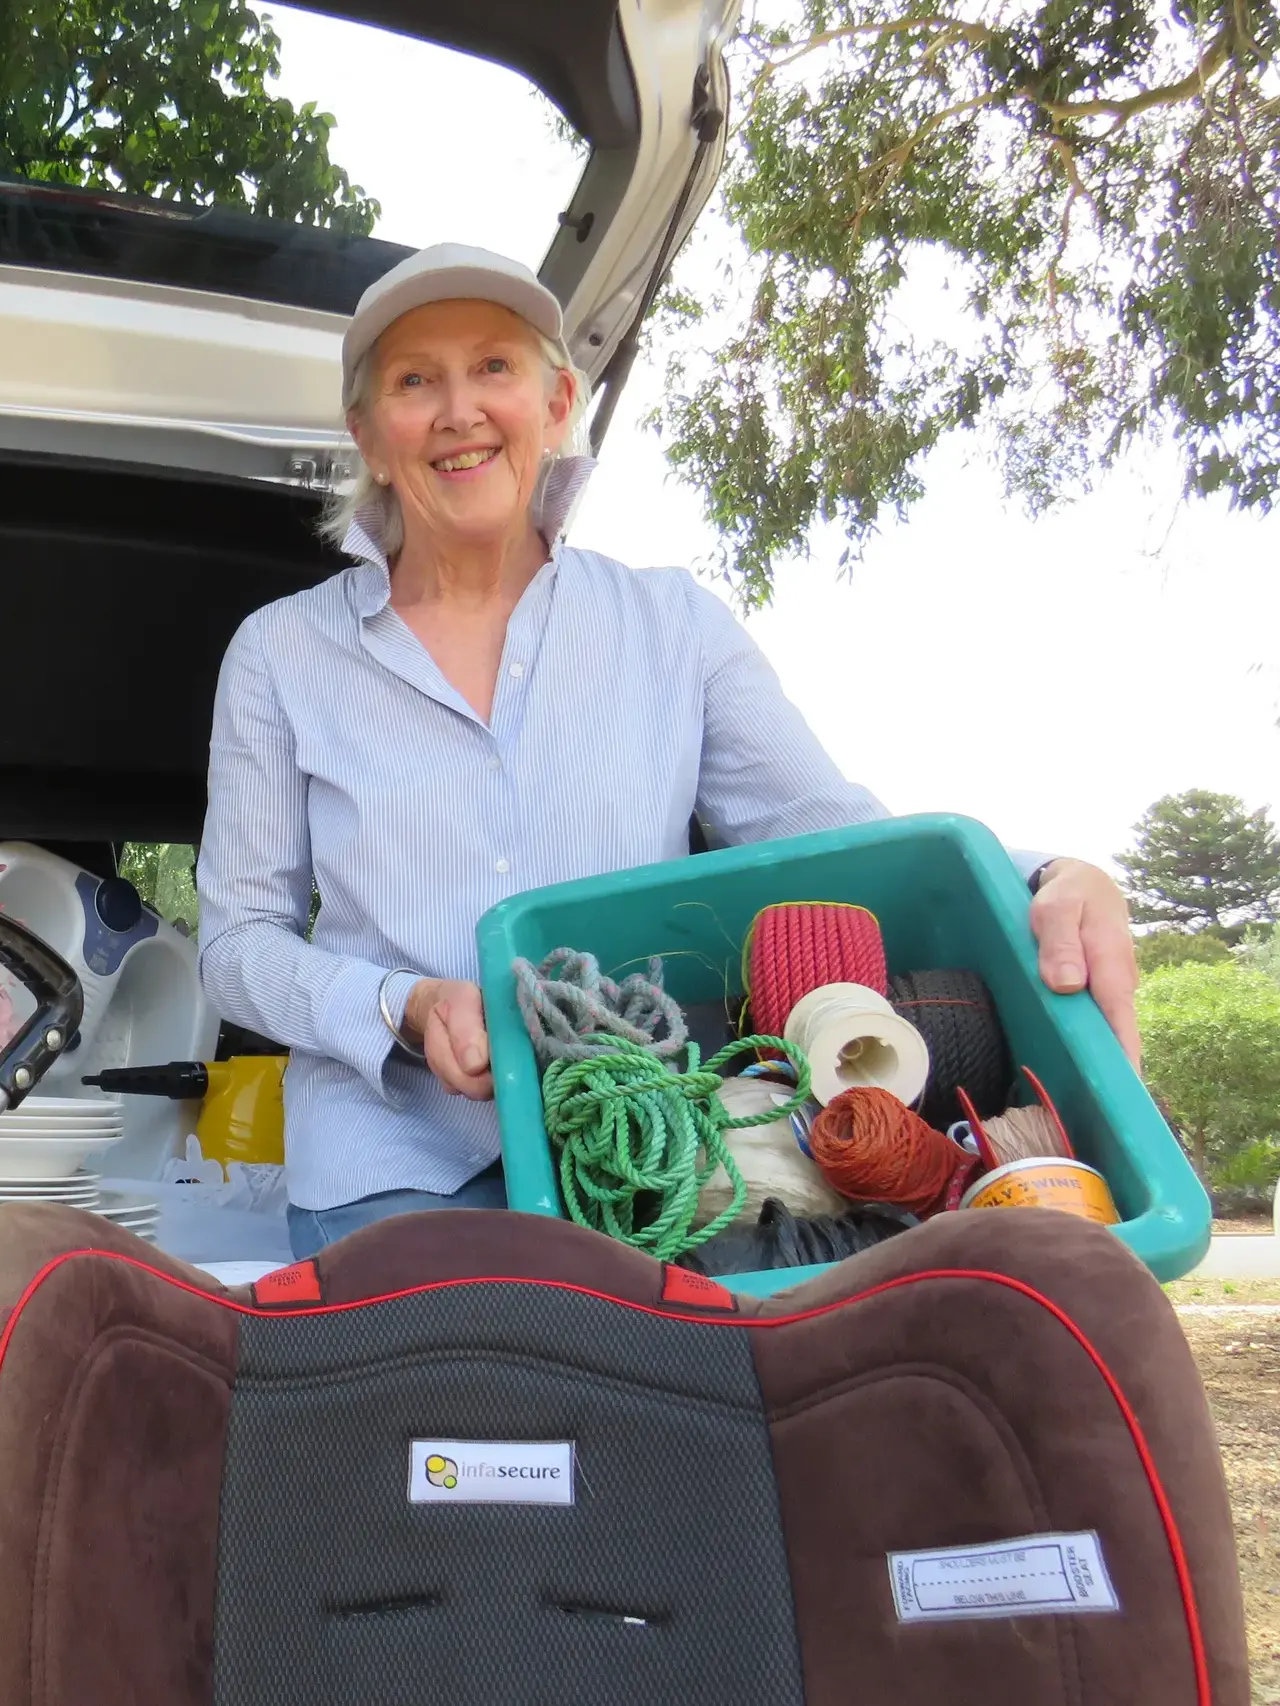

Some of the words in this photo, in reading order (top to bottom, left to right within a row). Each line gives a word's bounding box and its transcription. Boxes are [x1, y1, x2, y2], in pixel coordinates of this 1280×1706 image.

[1017, 1177, 1082, 1192] TWINE
[462, 1461, 561, 1479] infasecure
[1066, 1545, 1089, 1597] BOOSTER
[1078, 1558, 1094, 1586] SEAT
[953, 1593, 984, 1605] BELOW
